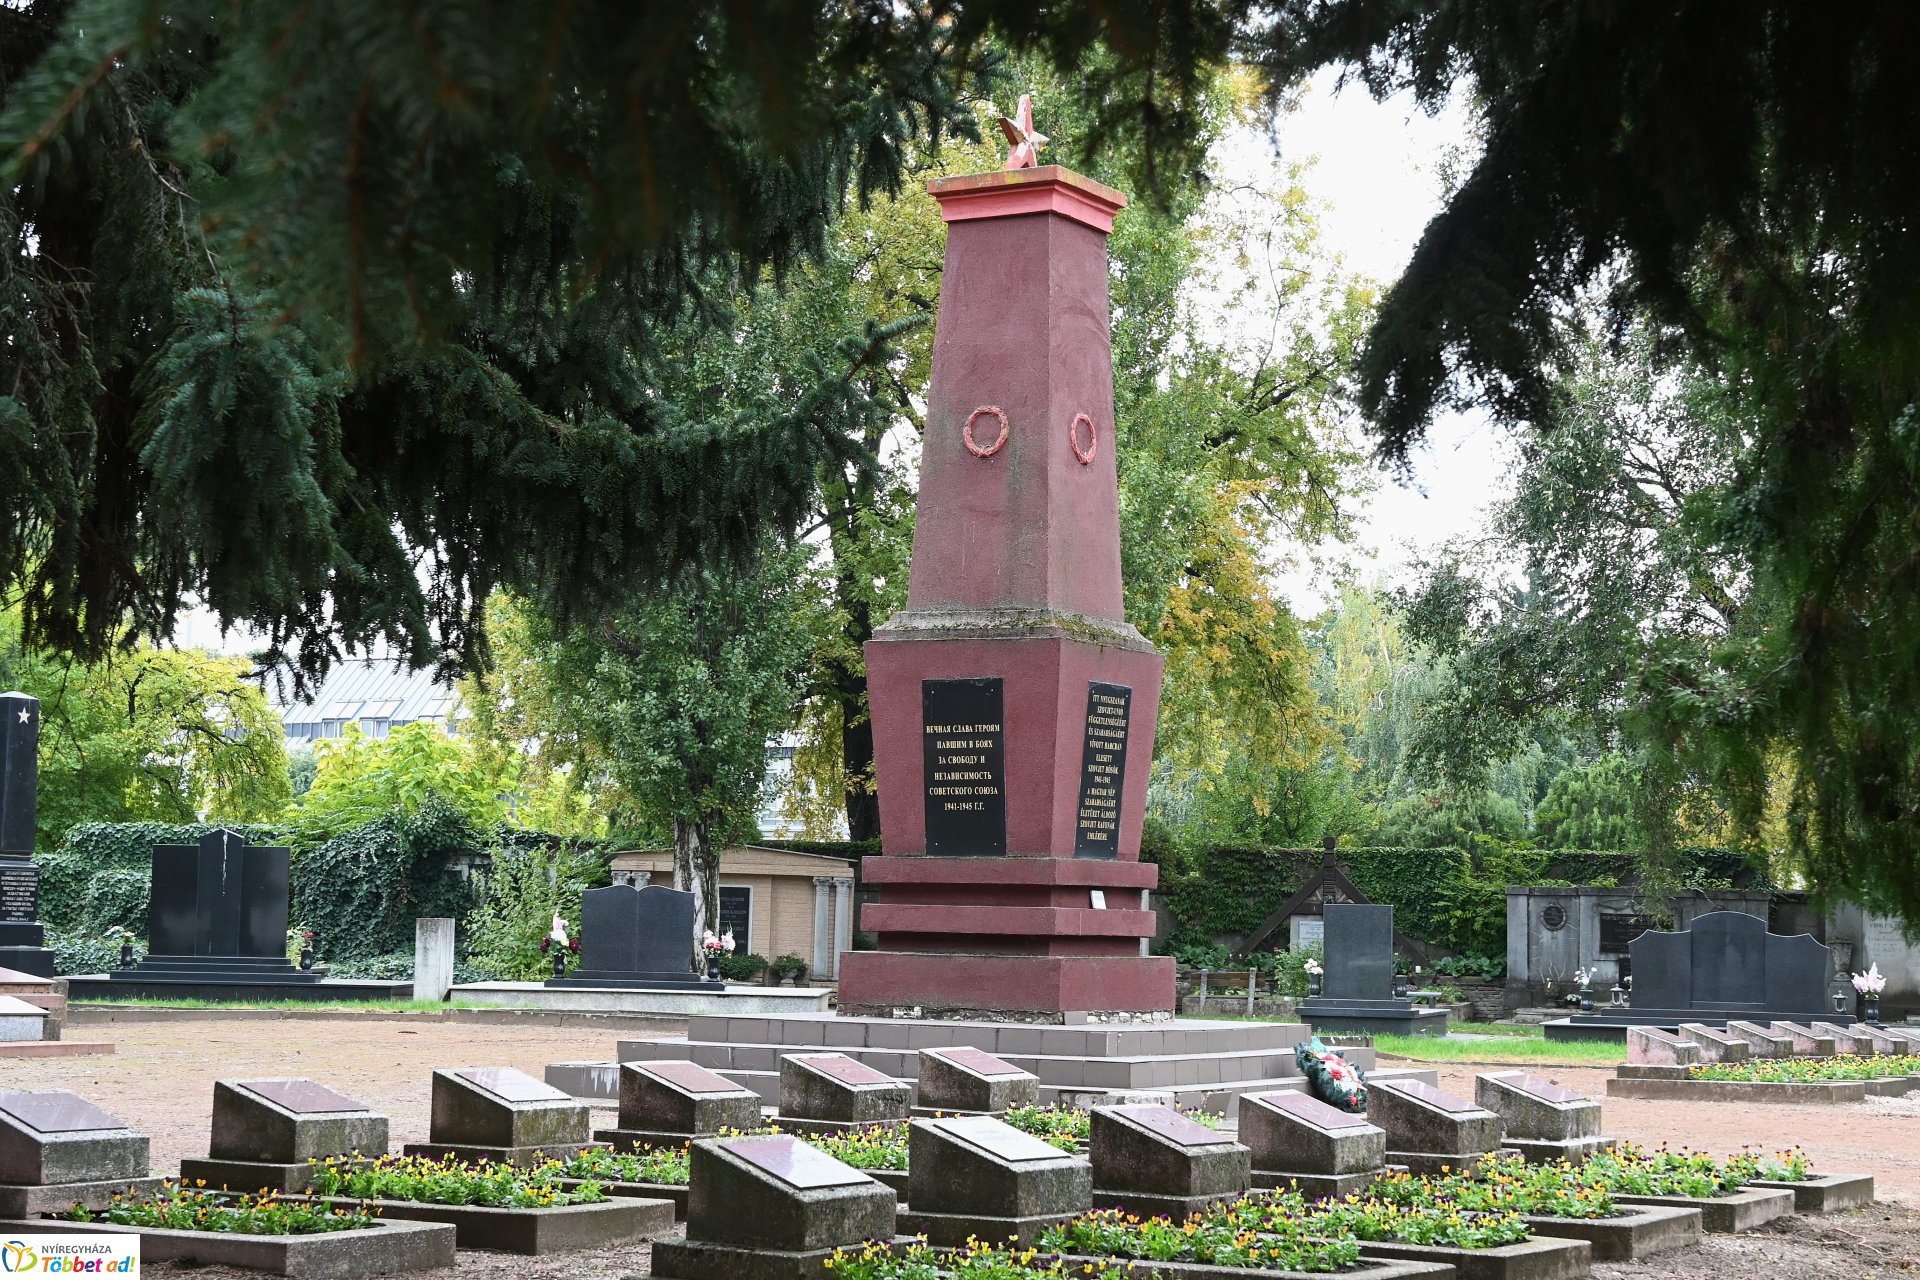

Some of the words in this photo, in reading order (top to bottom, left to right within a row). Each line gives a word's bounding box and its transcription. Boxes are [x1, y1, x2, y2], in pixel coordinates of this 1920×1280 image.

[926, 725, 951, 734] ВЕЧНАЯ
[952, 724, 973, 733] СЛАВА
[975, 724, 1000, 733] ГЕРОЯМ
[936, 740, 967, 749] ПАВШИМ
[969, 740, 974, 748] В
[975, 739, 993, 748] БОЯХ
[938, 755, 946, 764] ЗА
[947, 755, 978, 765] СВОБОДУ
[980, 755, 985, 763] И
[1096, 753, 1112, 763] ELESETT
[934, 771, 992, 780] НЕЗАВИСИМОСТЬ
[929, 786, 973, 796] СОВЕТСКОГО
[974, 786, 998, 795] СОЮЗА
[944, 802, 973, 811] 1941-1945
